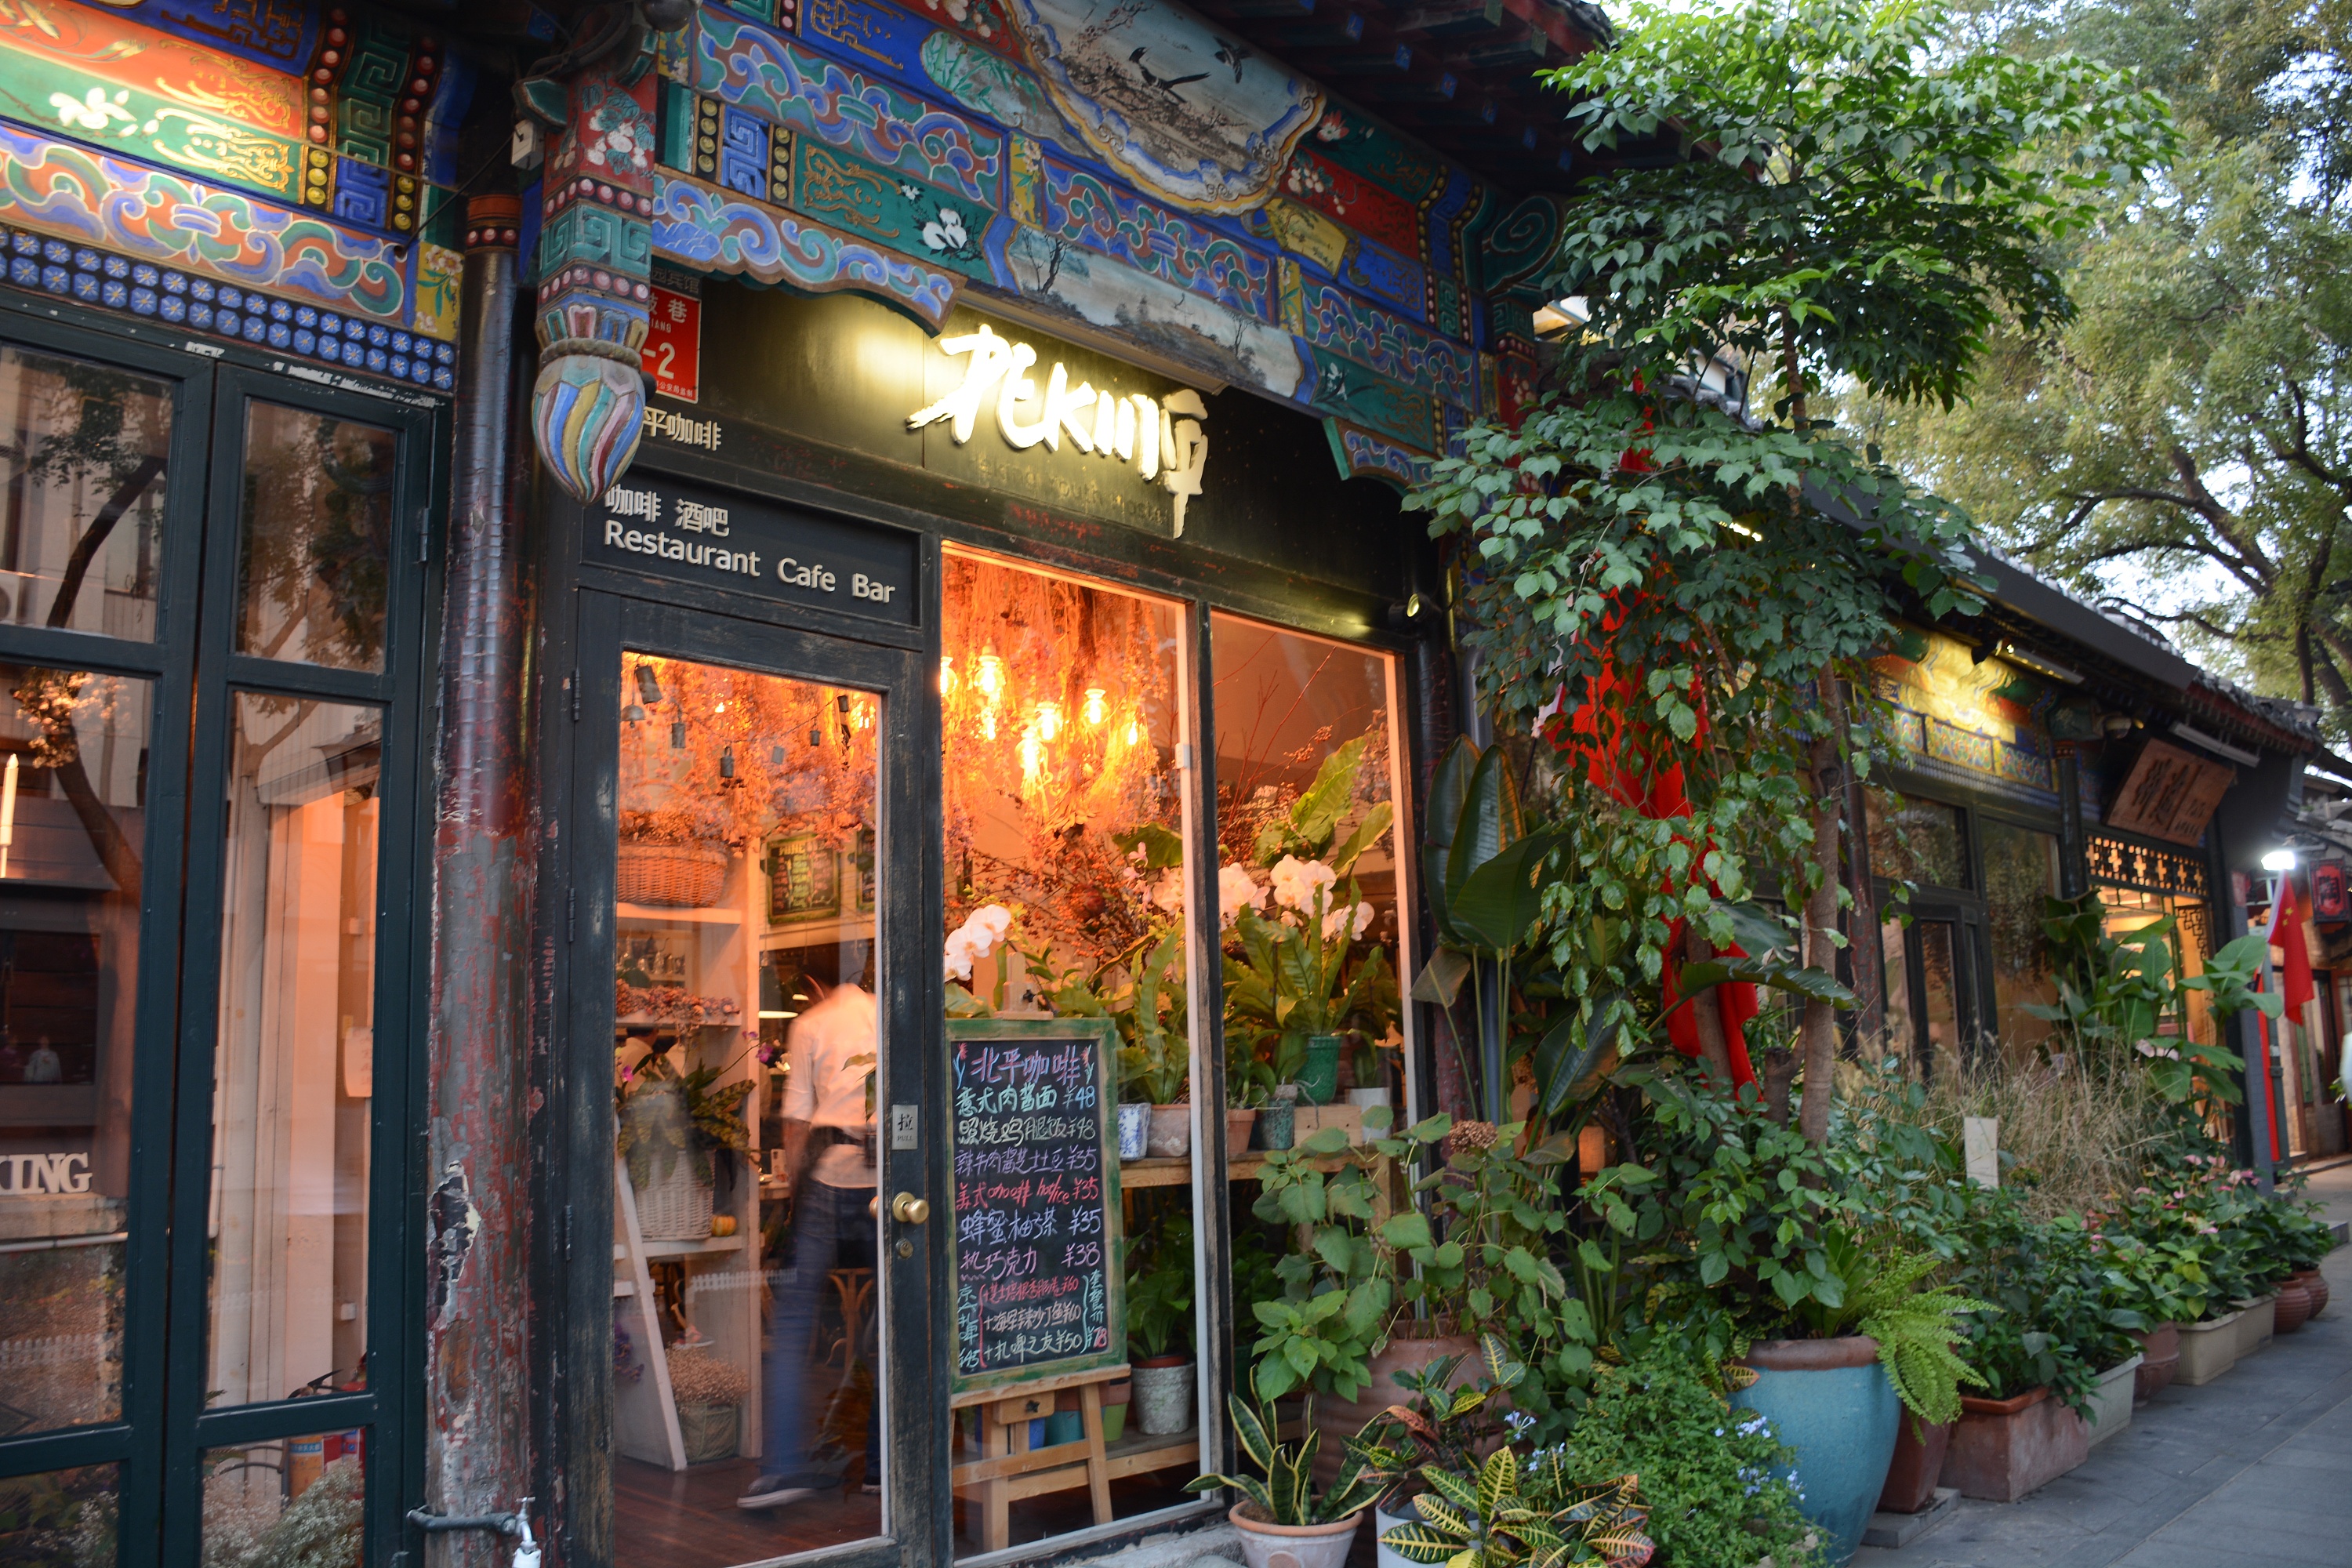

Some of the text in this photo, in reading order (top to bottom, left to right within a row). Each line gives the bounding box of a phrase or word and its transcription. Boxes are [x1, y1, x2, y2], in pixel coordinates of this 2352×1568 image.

[649, 317, 672, 334] IANG
[656, 380, 693, 398] 公安局监制
[604, 484, 730, 538] 咖啡 酒吧
[604, 519, 896, 604] Restaurant Cafe Bar
[969, 1044, 1081, 1088] 北平咖啡
[956, 1081, 1096, 1117] 意式肉酱面 ¥48
[898, 1113, 913, 1131] 拉
[1067, 1116, 1097, 1140] ¥48
[1065, 1144, 1098, 1172] ¥35
[956, 1178, 1033, 1211] 美式咖啡
[1071, 1176, 1099, 1201] ¥35
[959, 1205, 1102, 1247] 蜂蜜柚子茶 ¥35
[1061, 1241, 1101, 1269] ¥38
[1056, 1329, 1083, 1353] ¥50
